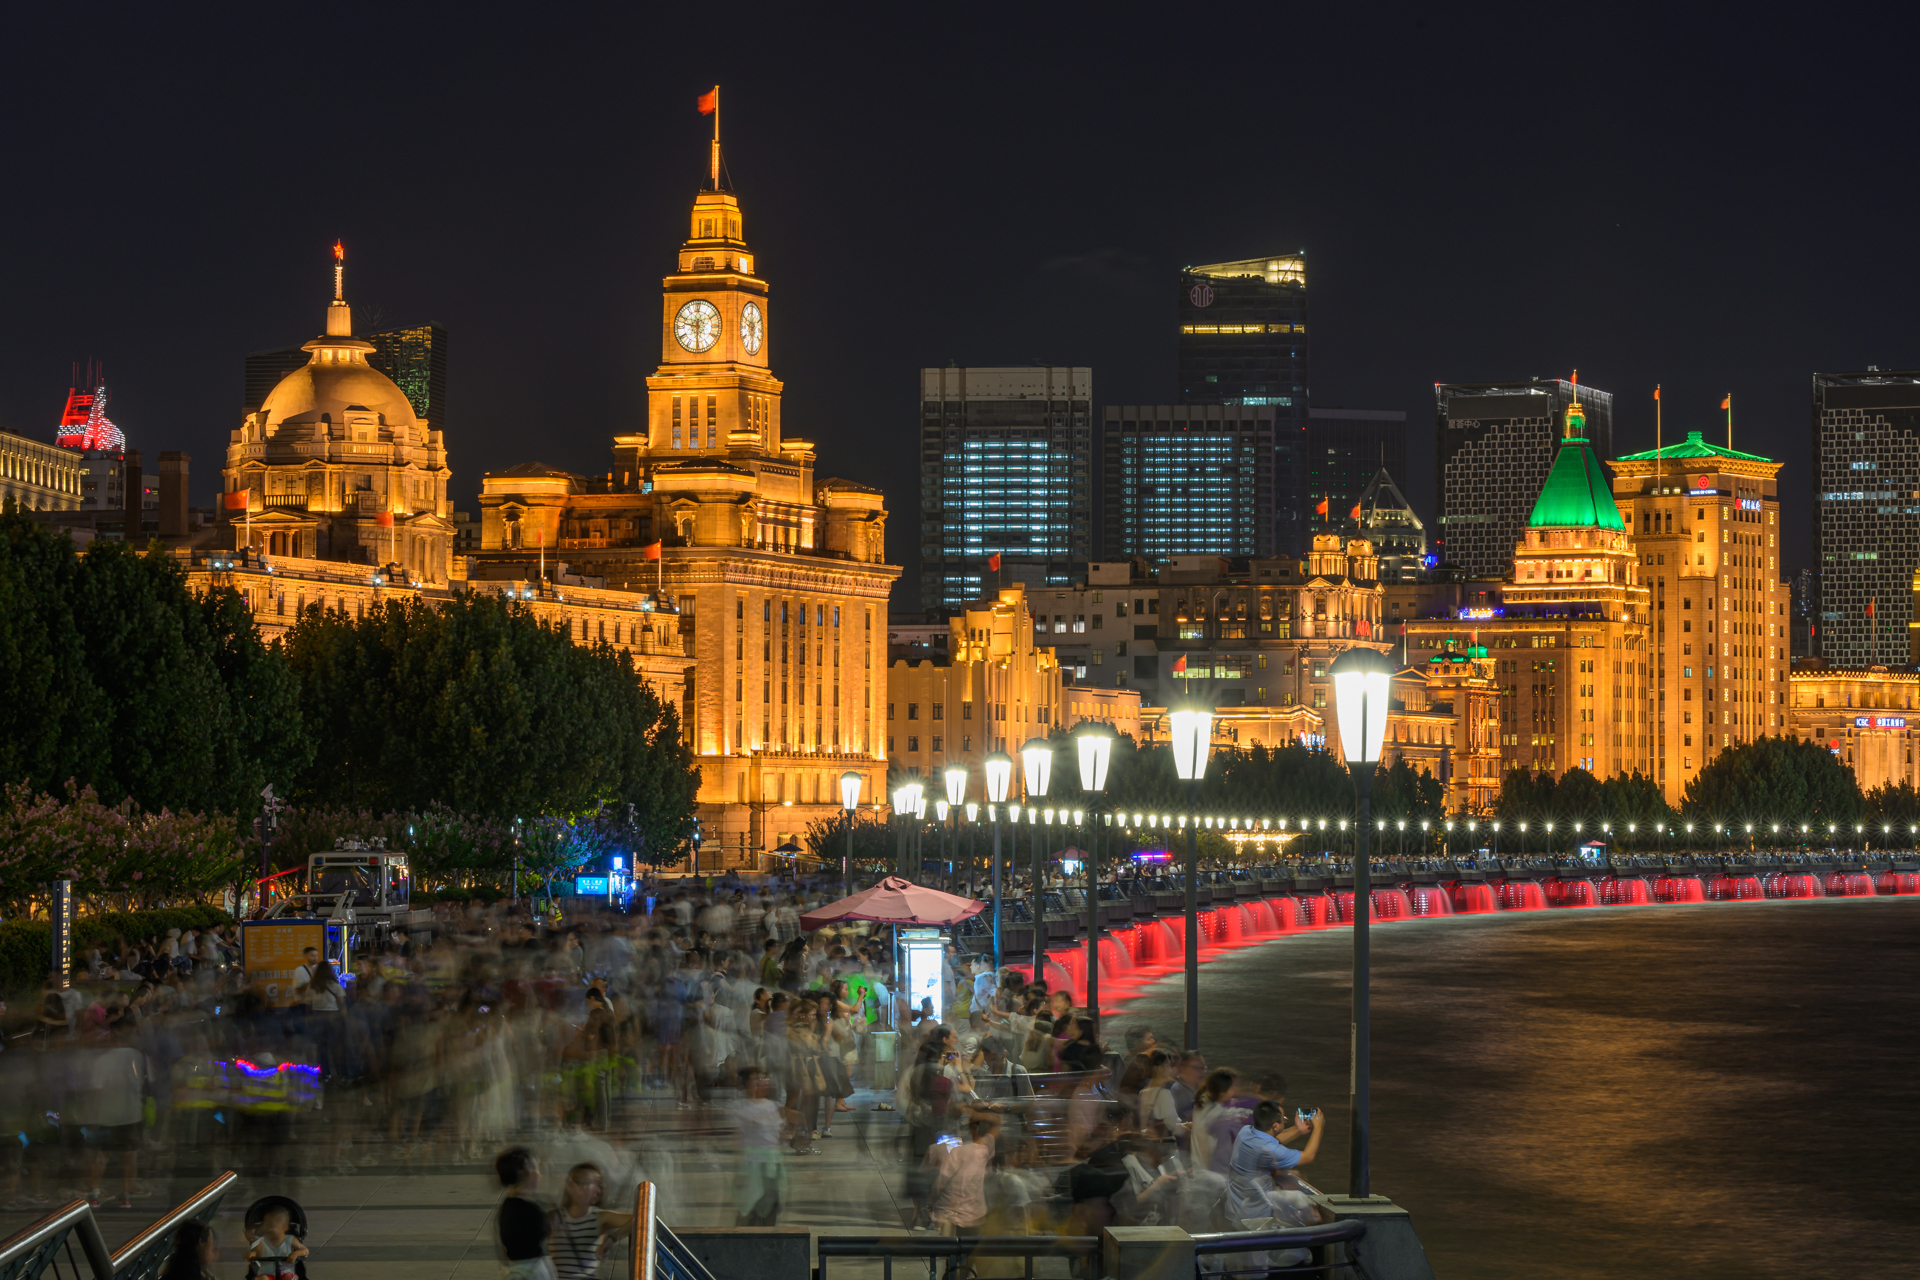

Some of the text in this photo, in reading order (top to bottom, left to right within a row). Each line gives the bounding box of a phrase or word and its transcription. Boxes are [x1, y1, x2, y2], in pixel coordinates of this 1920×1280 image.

[1741, 499, 1761, 511] 中国银行
[1356, 620, 1371, 637] AIA
[1856, 718, 1869, 726] ICBC
[1877, 718, 1905, 727] 中国工商银行
